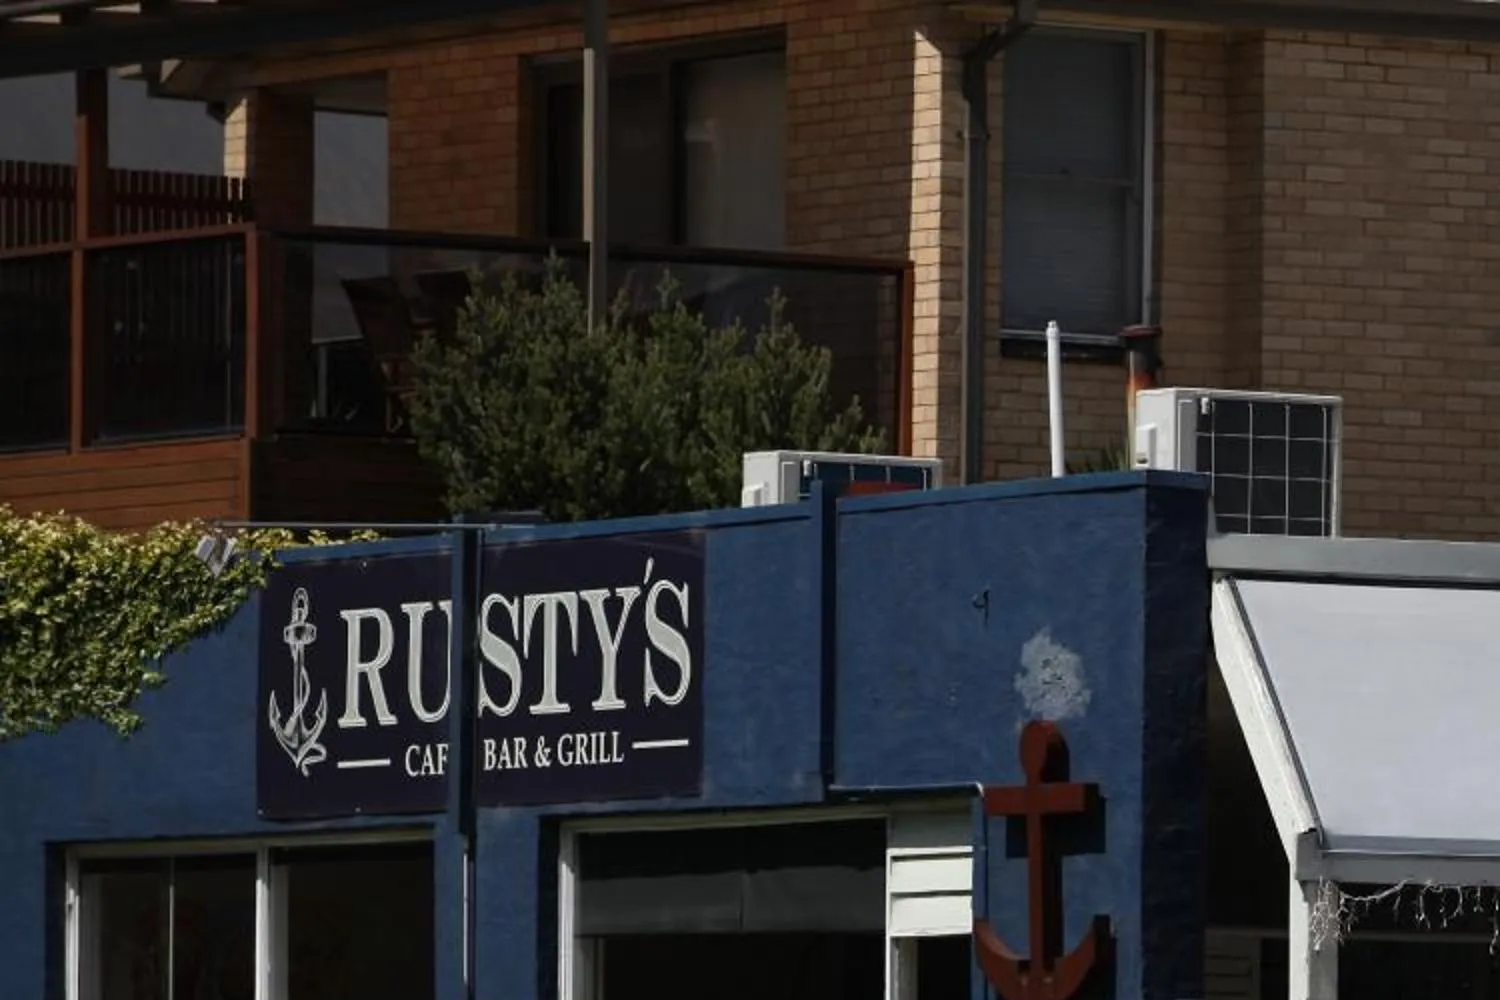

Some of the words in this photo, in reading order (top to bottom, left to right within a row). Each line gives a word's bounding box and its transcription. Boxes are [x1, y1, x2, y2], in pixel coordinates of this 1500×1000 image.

[338, 557, 691, 729] RUSTY'S
[405, 743, 449, 777] CAF
[483, 737, 528, 771] BAR
[534, 735, 552, 768] &
[557, 731, 624, 767] GRILL
